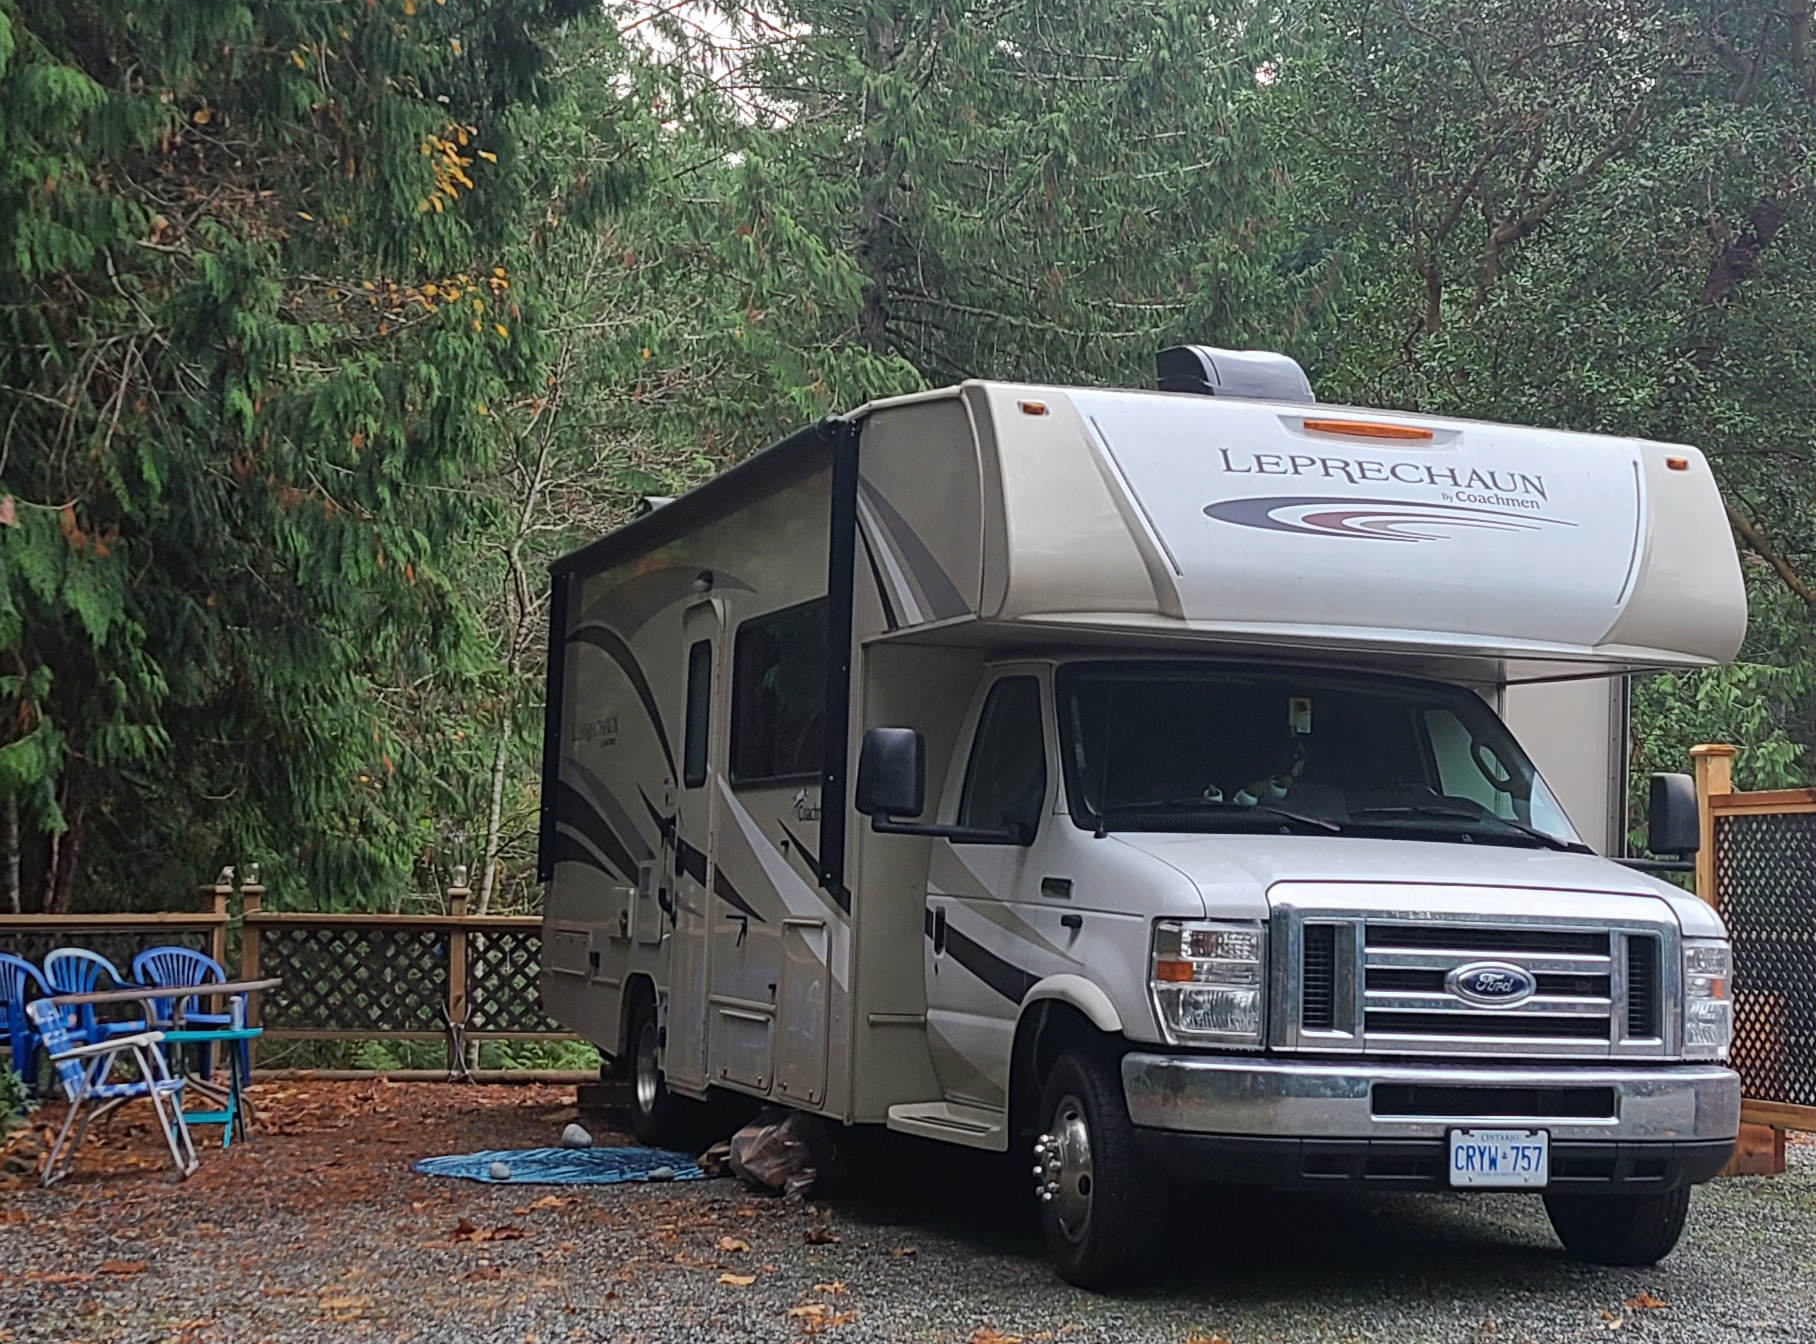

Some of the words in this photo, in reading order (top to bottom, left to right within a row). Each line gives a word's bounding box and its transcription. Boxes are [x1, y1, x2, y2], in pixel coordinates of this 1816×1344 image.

[1218, 447, 1548, 502] LEPRECHAUN
[1455, 491, 1540, 510] Coachmen
[1475, 973, 1514, 992] Ford
